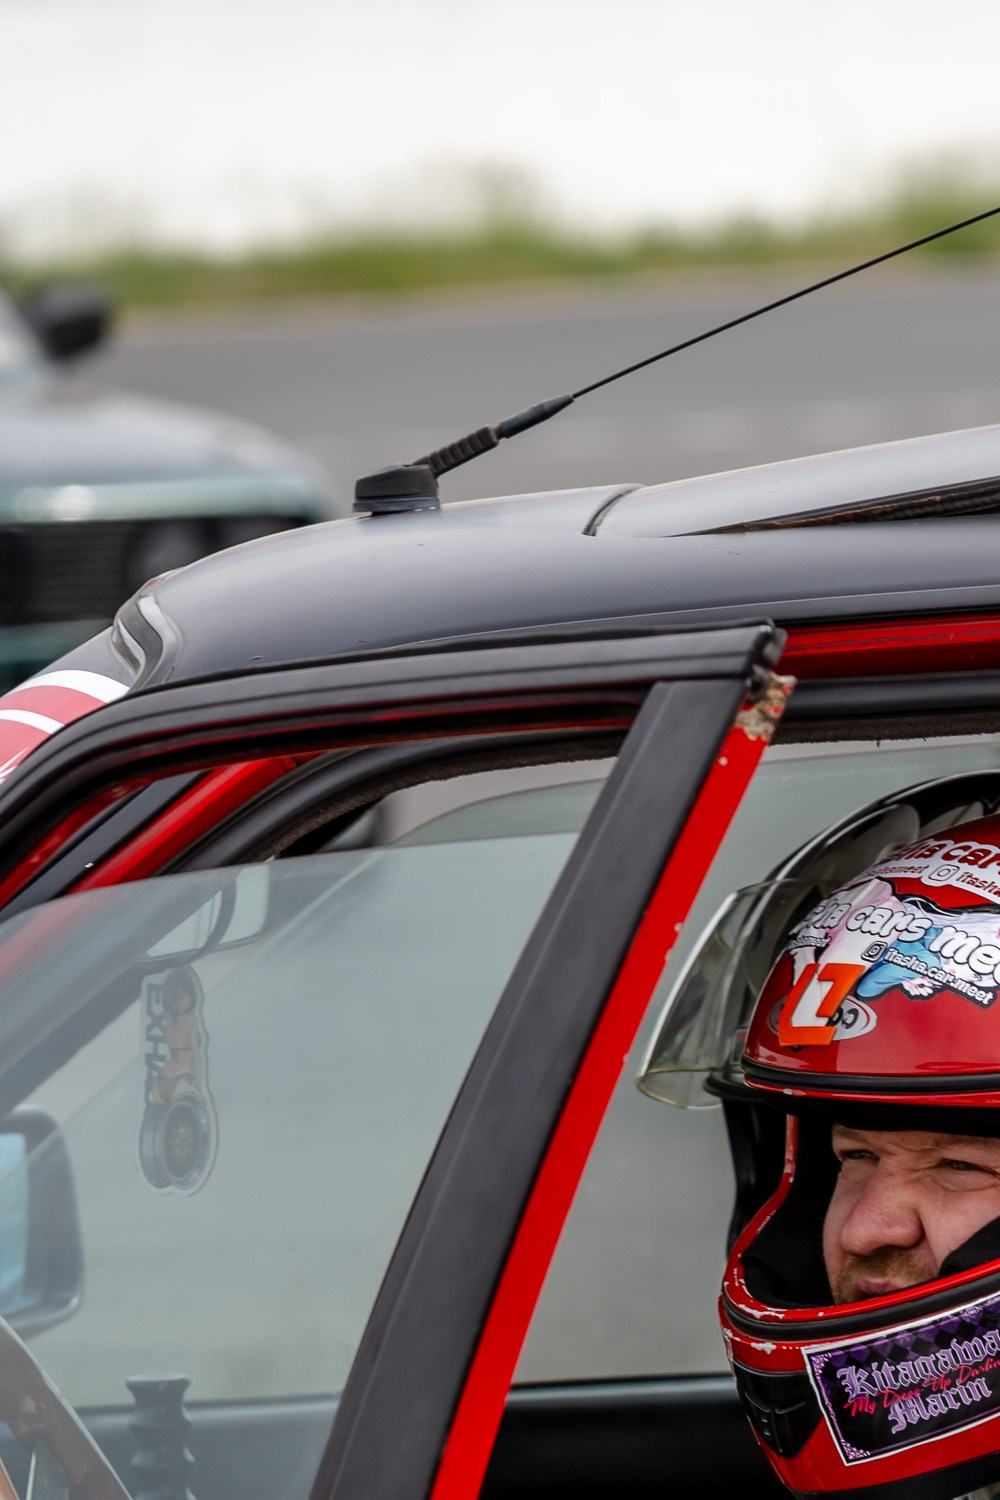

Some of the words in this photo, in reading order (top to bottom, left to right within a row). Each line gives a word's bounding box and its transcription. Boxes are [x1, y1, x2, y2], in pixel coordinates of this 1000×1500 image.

[846, 905, 934, 942] cars
[883, 948, 994, 1005] itasha.car.meet
[844, 1395, 877, 1417] My
[888, 1377, 992, 1434] Marin
